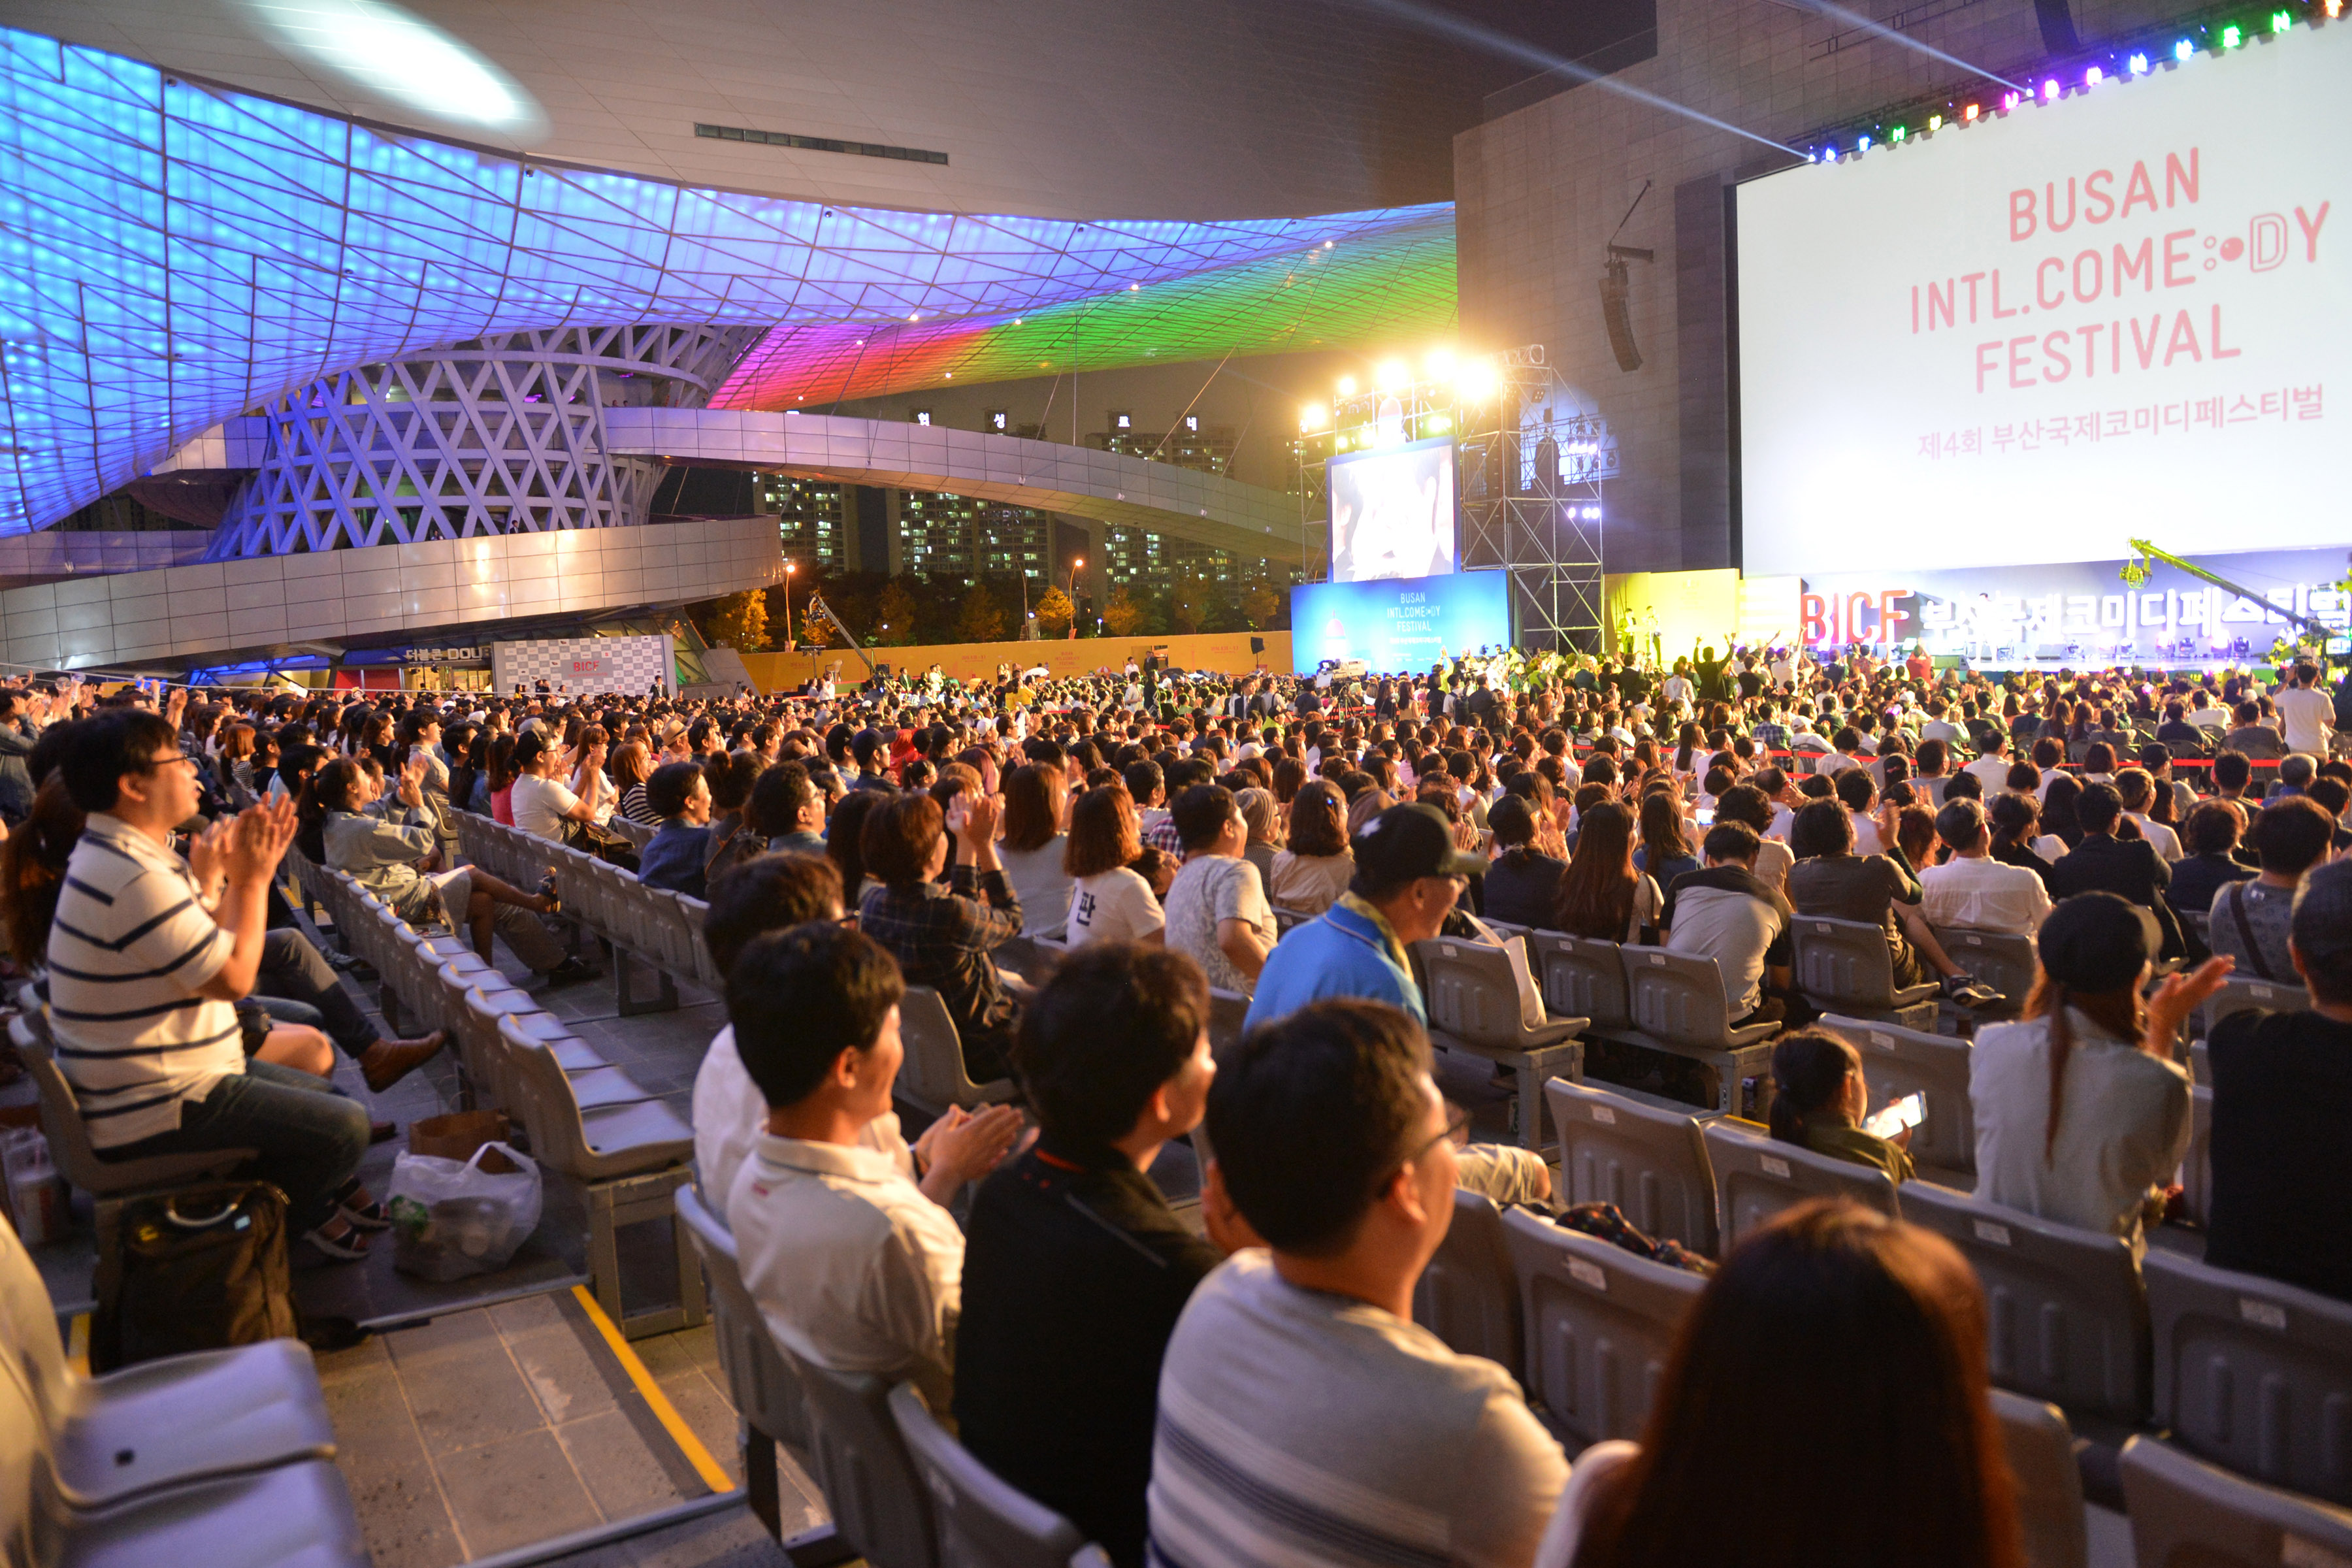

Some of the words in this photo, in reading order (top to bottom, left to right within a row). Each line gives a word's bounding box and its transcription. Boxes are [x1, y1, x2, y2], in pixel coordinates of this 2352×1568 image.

[2009, 146, 2200, 242] BUSAN
[1975, 304, 2242, 393] FESTIVAL
[1918, 426, 1983, 461] 제4회
[1991, 383, 2324, 453] 부산국제코미디페스티벌
[1400, 592, 1426, 604] BUSAN
[1801, 589, 1914, 644] BICF
[1397, 620, 1432, 632] FESTIVAL
[574, 660, 600, 672] BICF
